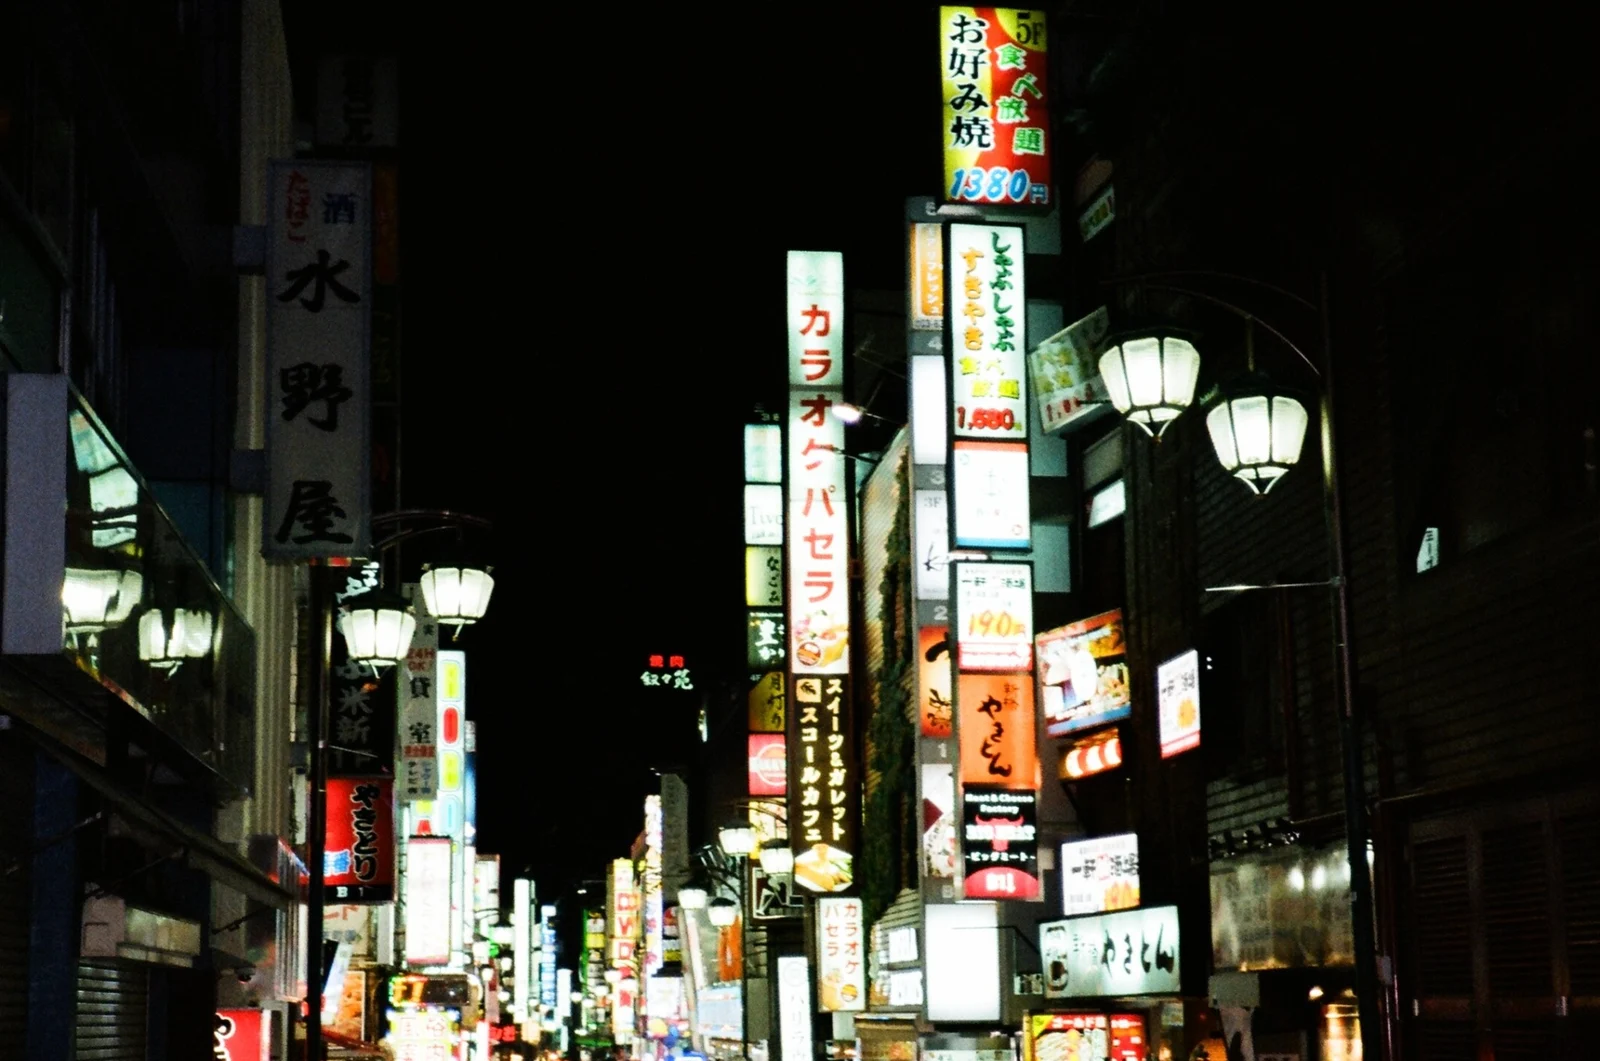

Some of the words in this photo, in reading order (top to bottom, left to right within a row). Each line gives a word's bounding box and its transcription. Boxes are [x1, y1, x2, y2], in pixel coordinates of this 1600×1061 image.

[1016, 12, 1044, 46] 5F
[949, 14, 993, 149] お好み焼
[994, 44, 1046, 155] 食べ放題
[959, 246, 986, 352] すきやき
[989, 230, 1014, 353] しゃぶしゃぶ
[273, 249, 363, 545] 水野屋
[976, 694, 1013, 779] やきとん
[349, 782, 380, 882] やきとり
[826, 903, 841, 958] パセラ
[843, 902, 860, 975] カラオケ
